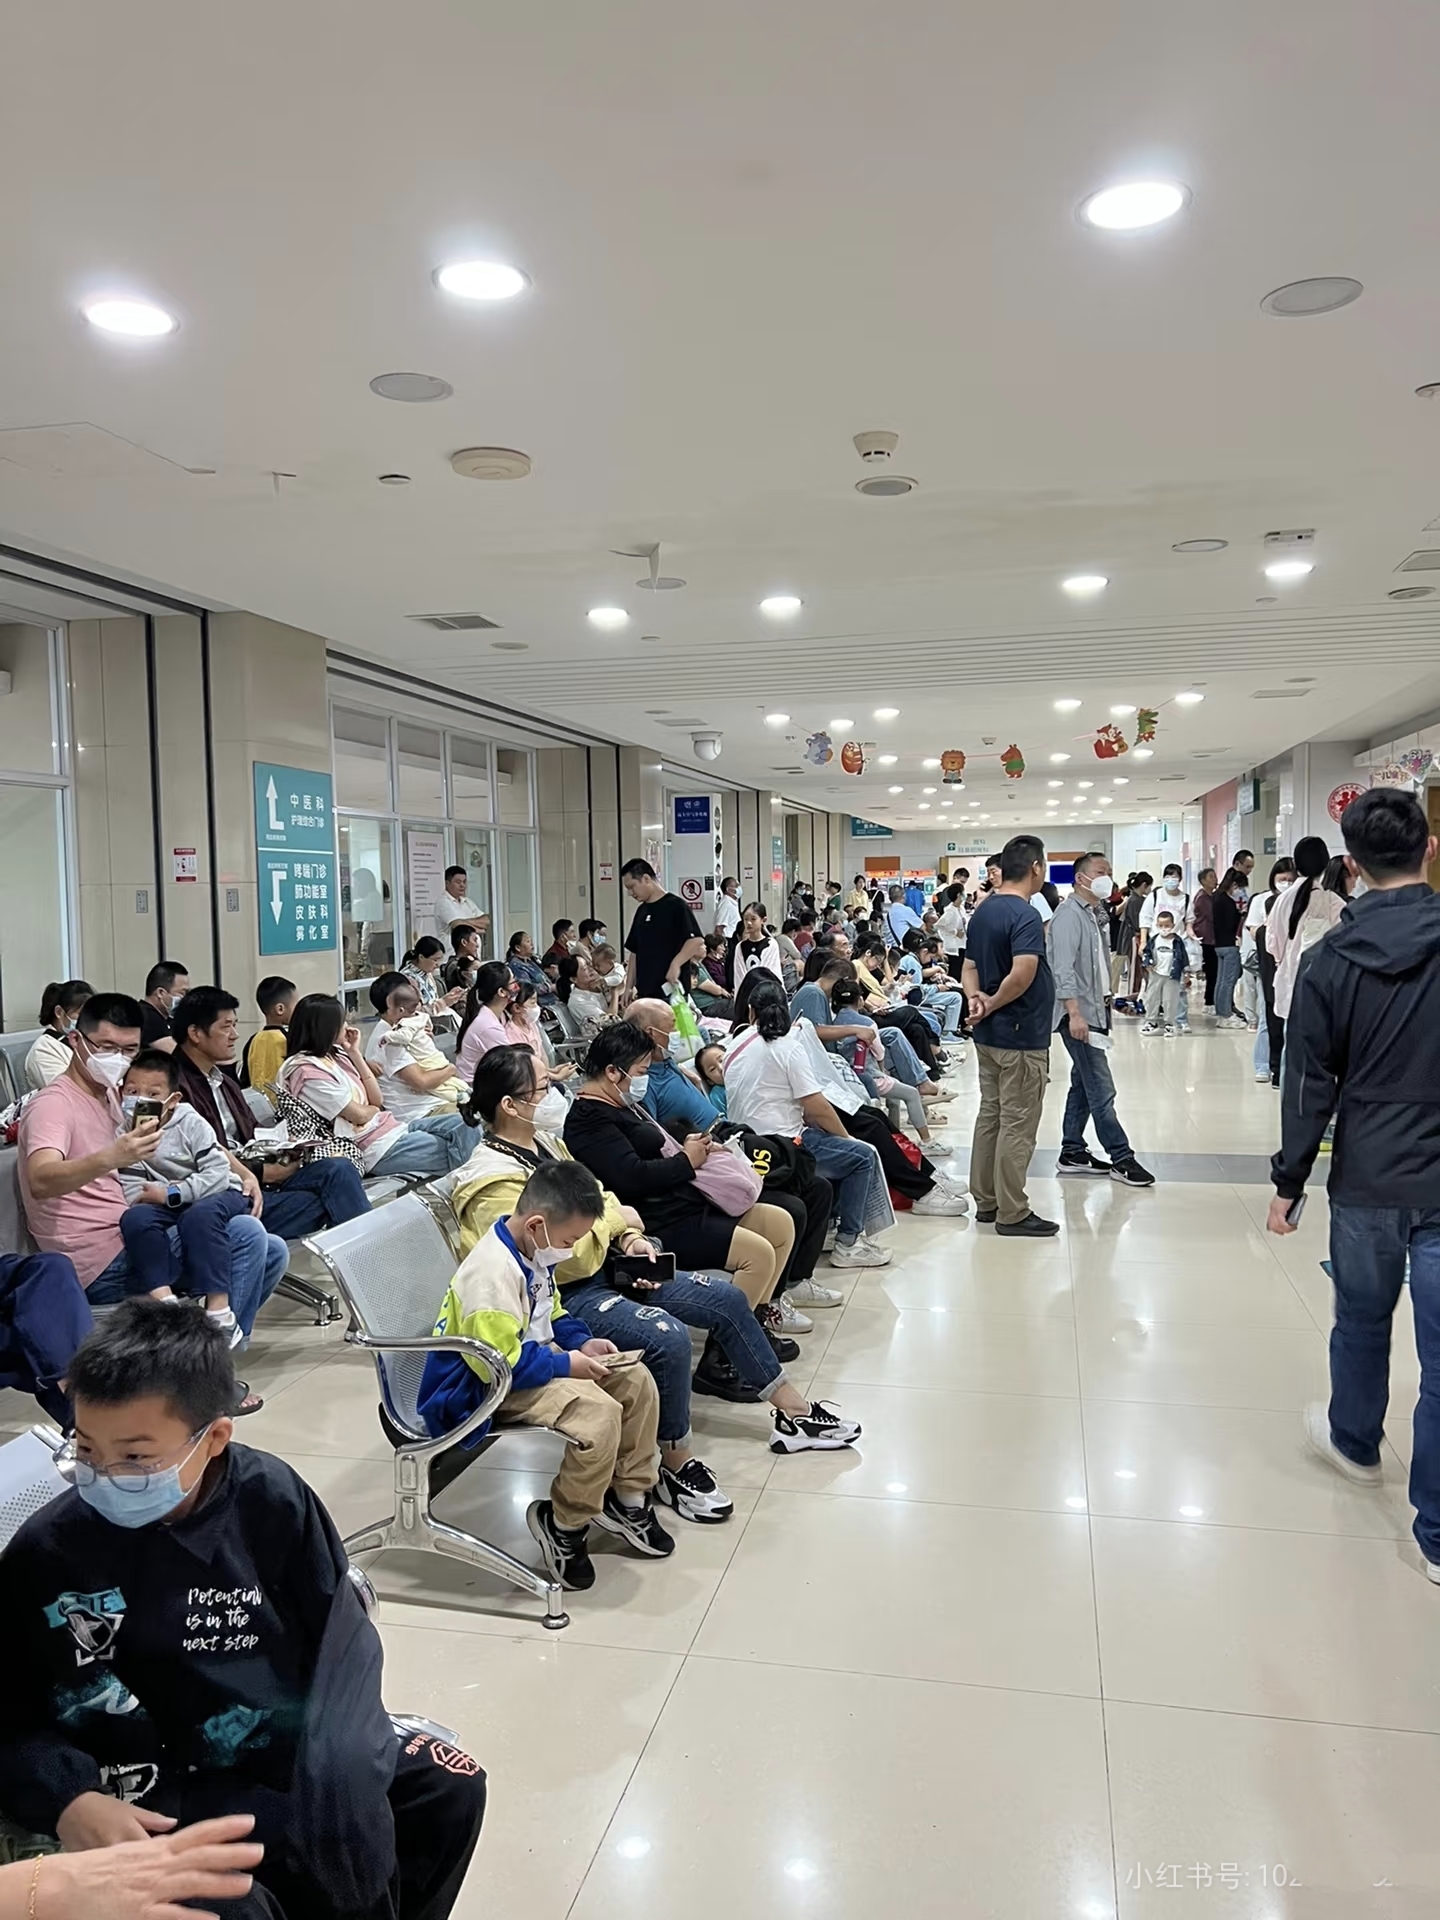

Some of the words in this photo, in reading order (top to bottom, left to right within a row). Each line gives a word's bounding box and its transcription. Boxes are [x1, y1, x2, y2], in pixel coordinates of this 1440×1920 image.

[290, 793, 325, 811] 中医科
[293, 863, 327, 879] 哮喘门诊
[294, 884, 328, 899] 肺功能室
[295, 904, 329, 920] 皮肤科
[295, 924, 330, 941] 雾化室
[188, 1585, 262, 1606] Potential
[186, 1612, 203, 1631] is
[206, 1612, 222, 1629] in
[225, 1605, 250, 1628] the
[182, 1635, 220, 1651] next
[223, 1634, 259, 1651] step
